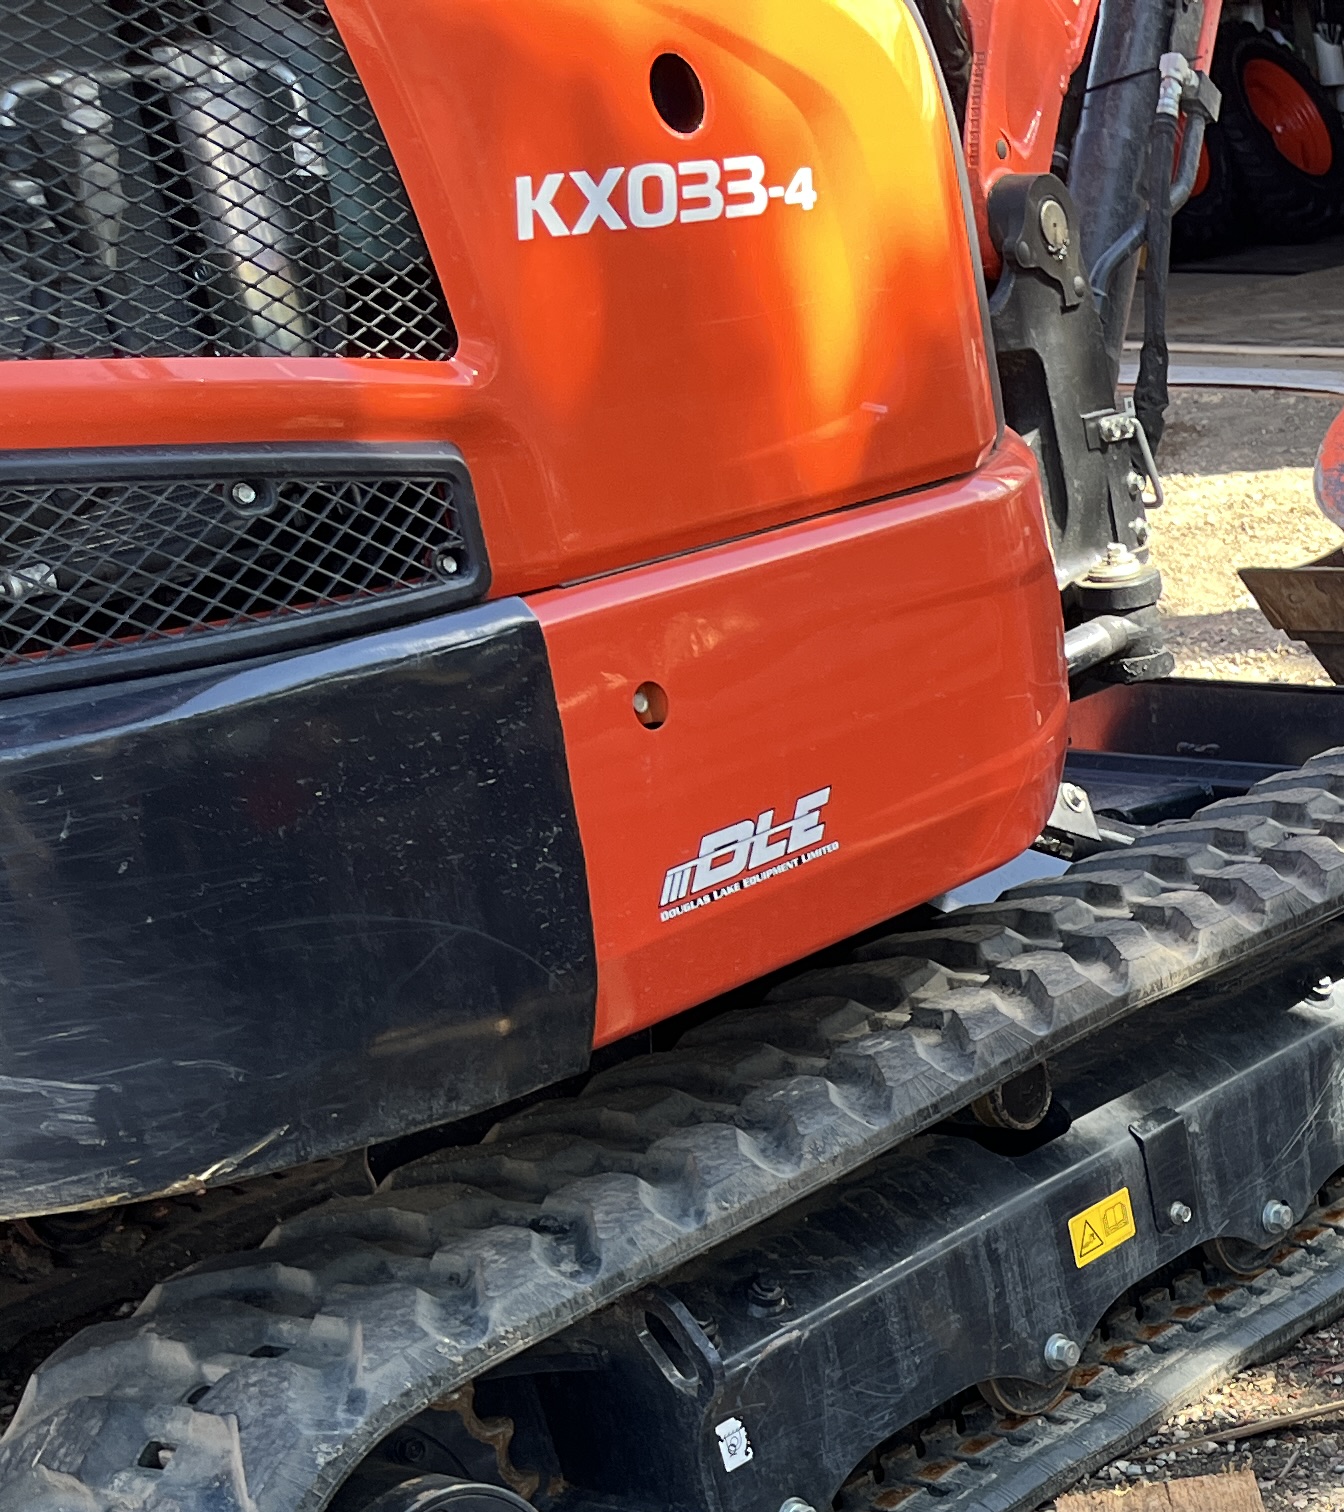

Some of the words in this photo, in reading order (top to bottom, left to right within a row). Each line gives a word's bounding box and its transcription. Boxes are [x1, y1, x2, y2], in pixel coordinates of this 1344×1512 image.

[515, 154, 818, 242] KX033-4
[660, 894, 712, 923] DOUGLAS
[712, 881, 741, 902] LAKE
[742, 857, 800, 889] EQUIPMENT
[801, 840, 840, 865] LIMITED
